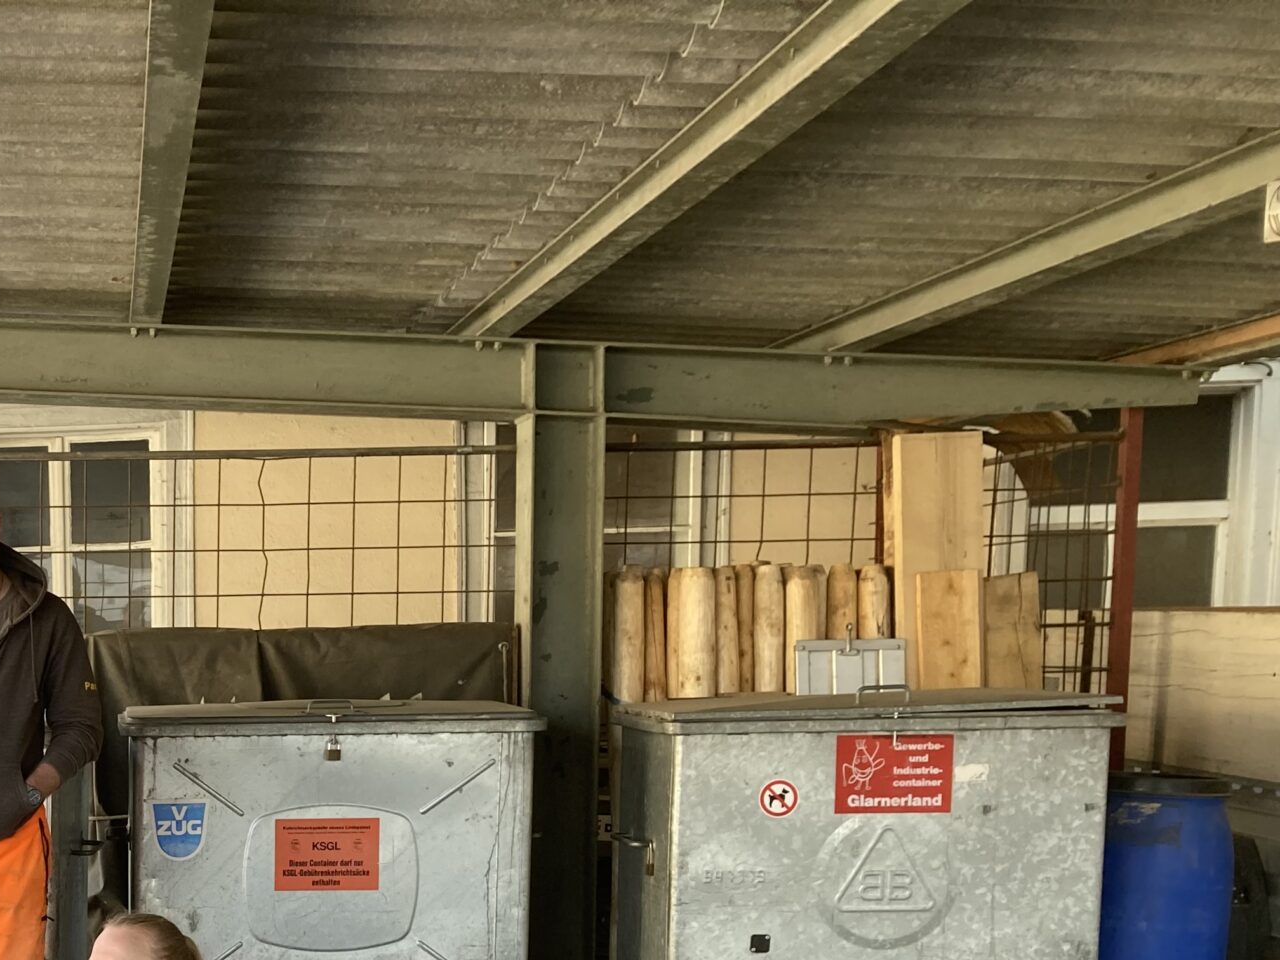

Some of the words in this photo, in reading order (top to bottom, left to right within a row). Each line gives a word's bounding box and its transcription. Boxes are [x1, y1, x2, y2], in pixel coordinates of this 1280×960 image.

[894, 742, 944, 750] Gewerbe-
[908, 754, 928, 762] und
[893, 766, 943, 774] Industrie-
[892, 778, 942, 787] container
[848, 794, 942, 807] Glarnerland
[171, 806, 188, 820] V
[157, 820, 201, 836] ZUG
[312, 842, 341, 850] KSGL
